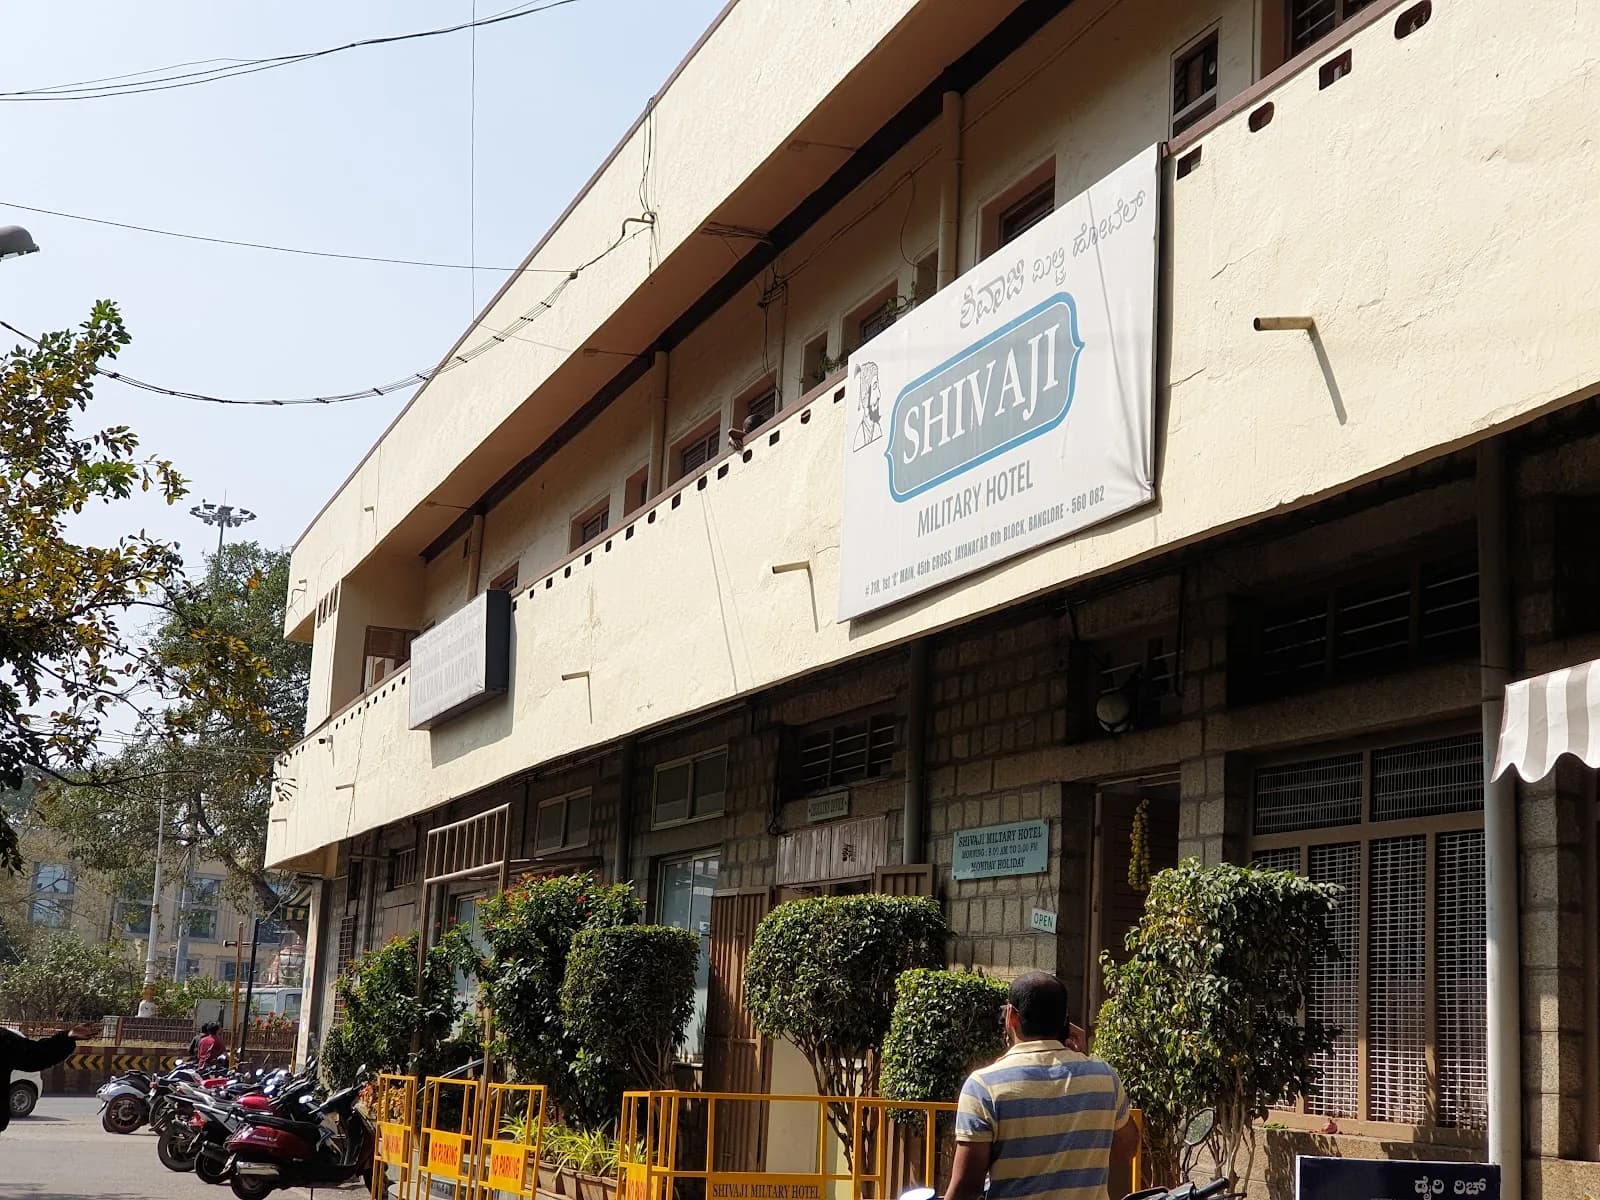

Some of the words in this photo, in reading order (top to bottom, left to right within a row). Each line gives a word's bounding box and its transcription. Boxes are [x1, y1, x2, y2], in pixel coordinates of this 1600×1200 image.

[960, 259, 1025, 329] ಶಿವಾಜಿ
[1072, 189, 1146, 258] ಹೋಟೆಲ್
[903, 323, 1060, 464] SHIVAJI
[917, 482, 981, 537] MILITARY
[986, 460, 1033, 507] HOTEL
[917, 559, 930, 576] 45th
[1003, 519, 1027, 541] BLOCK,
[1028, 503, 1064, 532] BANGLORE
[1071, 493, 1087, 514] 560
[1089, 485, 1105, 506] 082
[958, 832, 984, 848] SHIVAJI
[987, 829, 1016, 844] MILTARY
[1018, 826, 1042, 840] HOTEL
[1009, 844, 1016, 854] TO
[997, 856, 1026, 870] HOLIDAY
[1033, 912, 1053, 928] OPEN
[431, 1142, 438, 1161] NO
[438, 1143, 458, 1168] PARKING
[492, 1154, 499, 1176] NO
[500, 1155, 520, 1180] PARKING
[712, 1183, 748, 1198] SHIVAJI
[750, 1184, 790, 1199] MILTARY
[791, 1185, 821, 1199] HOTEL
